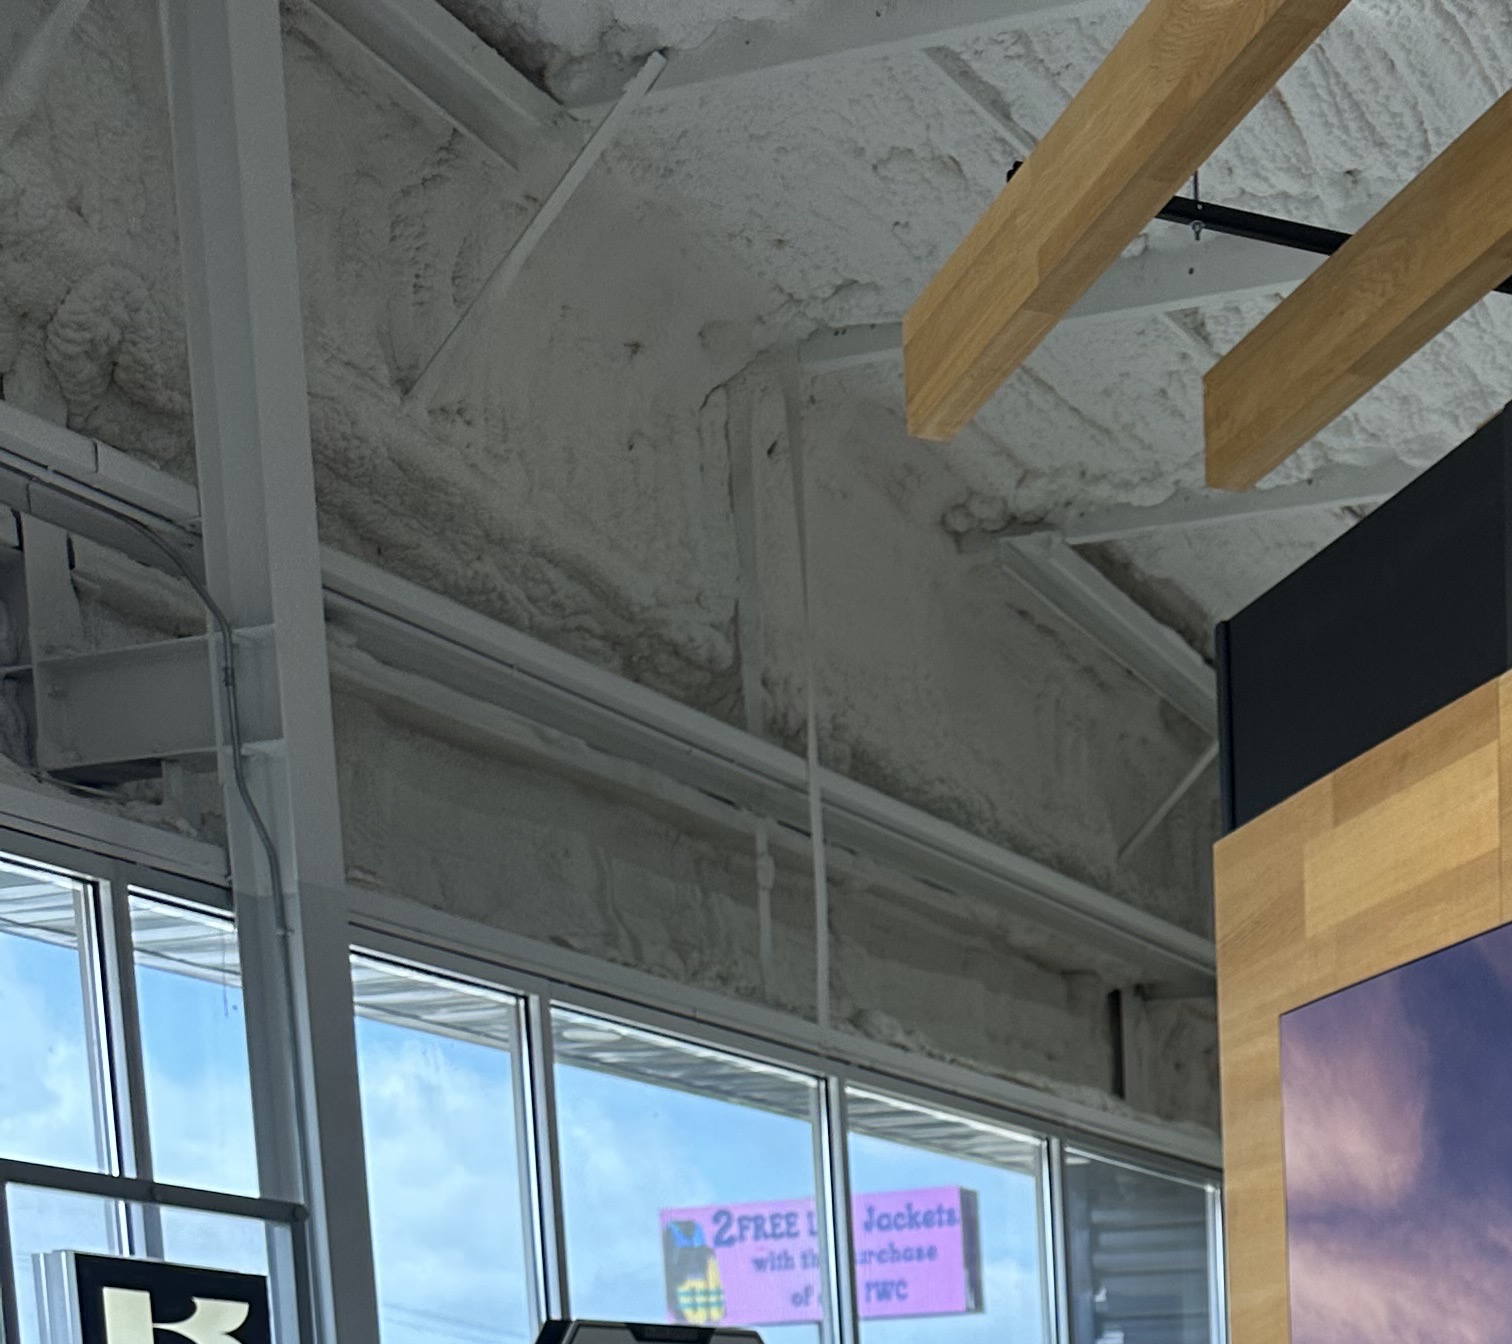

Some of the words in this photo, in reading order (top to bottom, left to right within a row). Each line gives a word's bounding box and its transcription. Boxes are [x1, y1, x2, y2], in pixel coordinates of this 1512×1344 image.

[737, 1210, 800, 1242] FREE
[863, 1202, 960, 1232] Jackets
[752, 1249, 796, 1272] with
[800, 1248, 821, 1270] th
[855, 1241, 938, 1265] urchase
[791, 1284, 814, 1307] of
